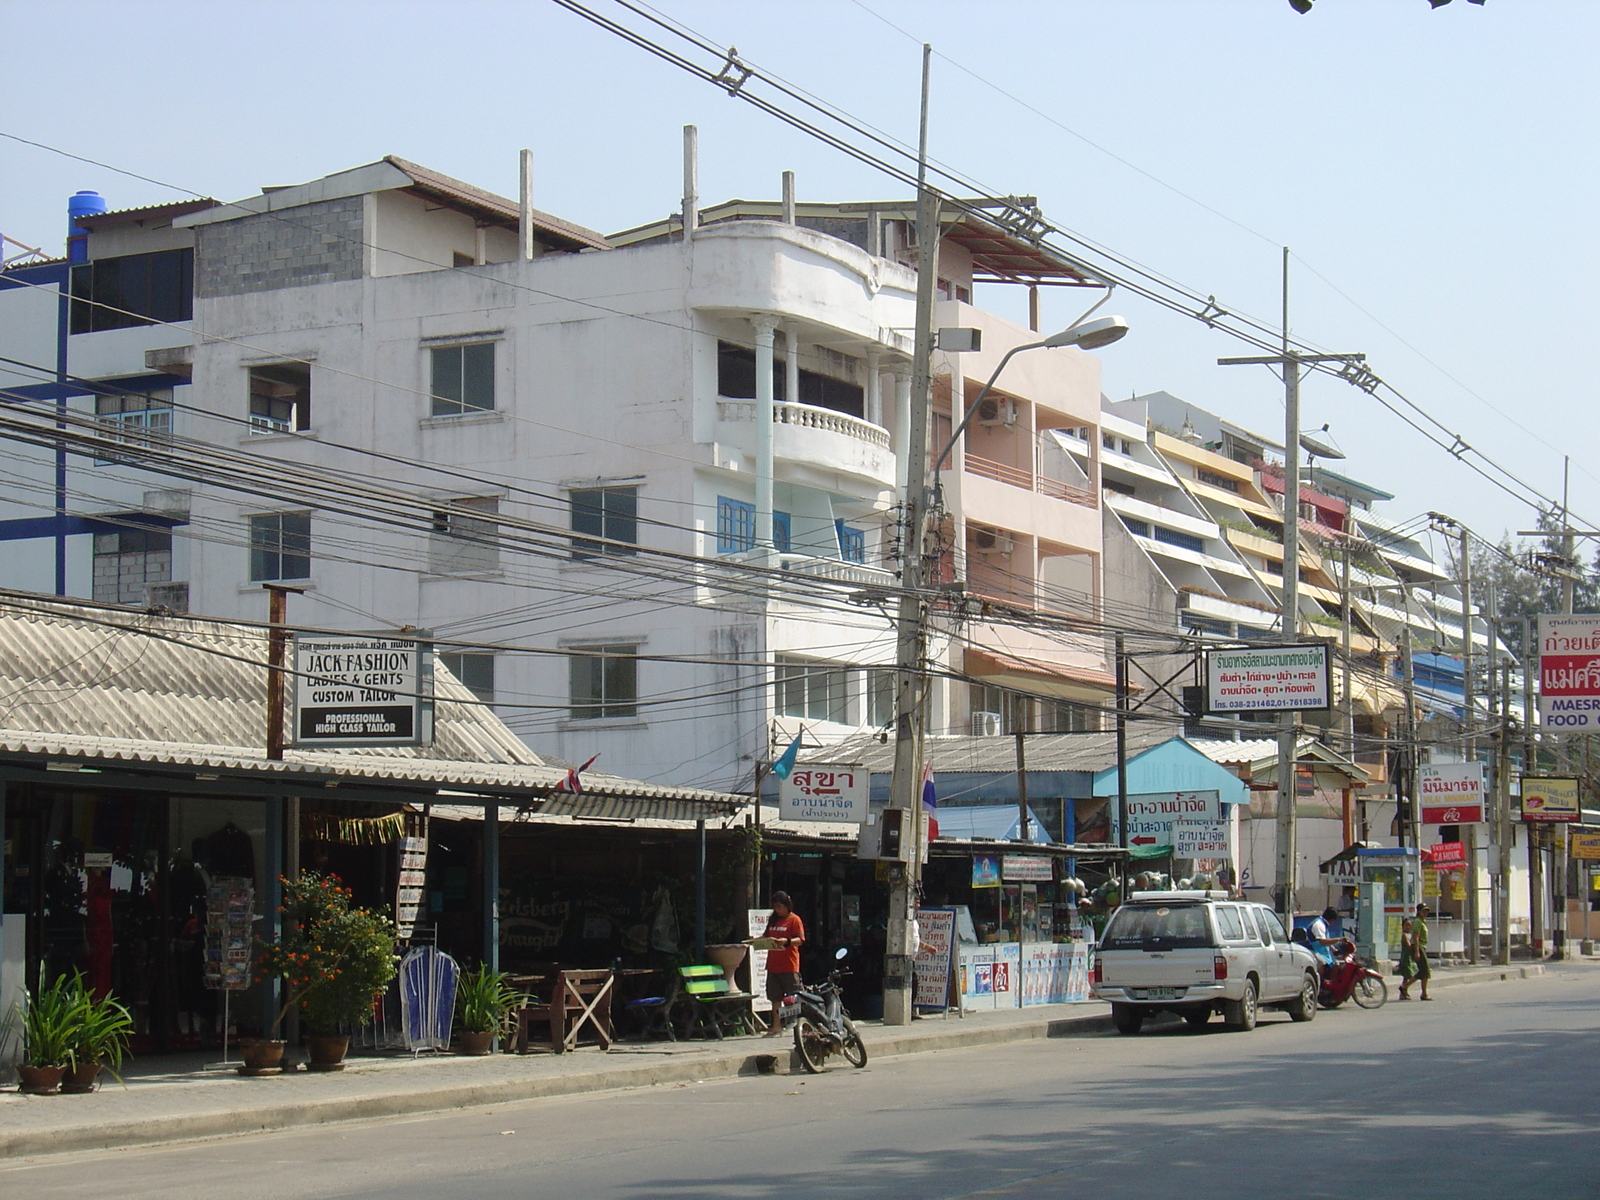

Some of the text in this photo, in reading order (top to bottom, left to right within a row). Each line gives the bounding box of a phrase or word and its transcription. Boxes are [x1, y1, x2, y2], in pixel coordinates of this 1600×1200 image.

[306, 652, 409, 673] JACK FASHION
[307, 673, 403, 687] LADIES & GENTS
[312, 690, 396, 703] CUSTOM TAILOR
[325, 713, 386, 724] PROFESSIONAL
[1547, 714, 1589, 726] FOOD
[315, 722, 397, 734] HIGH CLASS TAILOR
[792, 770, 855, 795] สุขา
[791, 796, 853, 809] อาบน้ำจืด
[1329, 860, 1361, 877] TAXI
[499, 896, 571, 922] arlsberg
